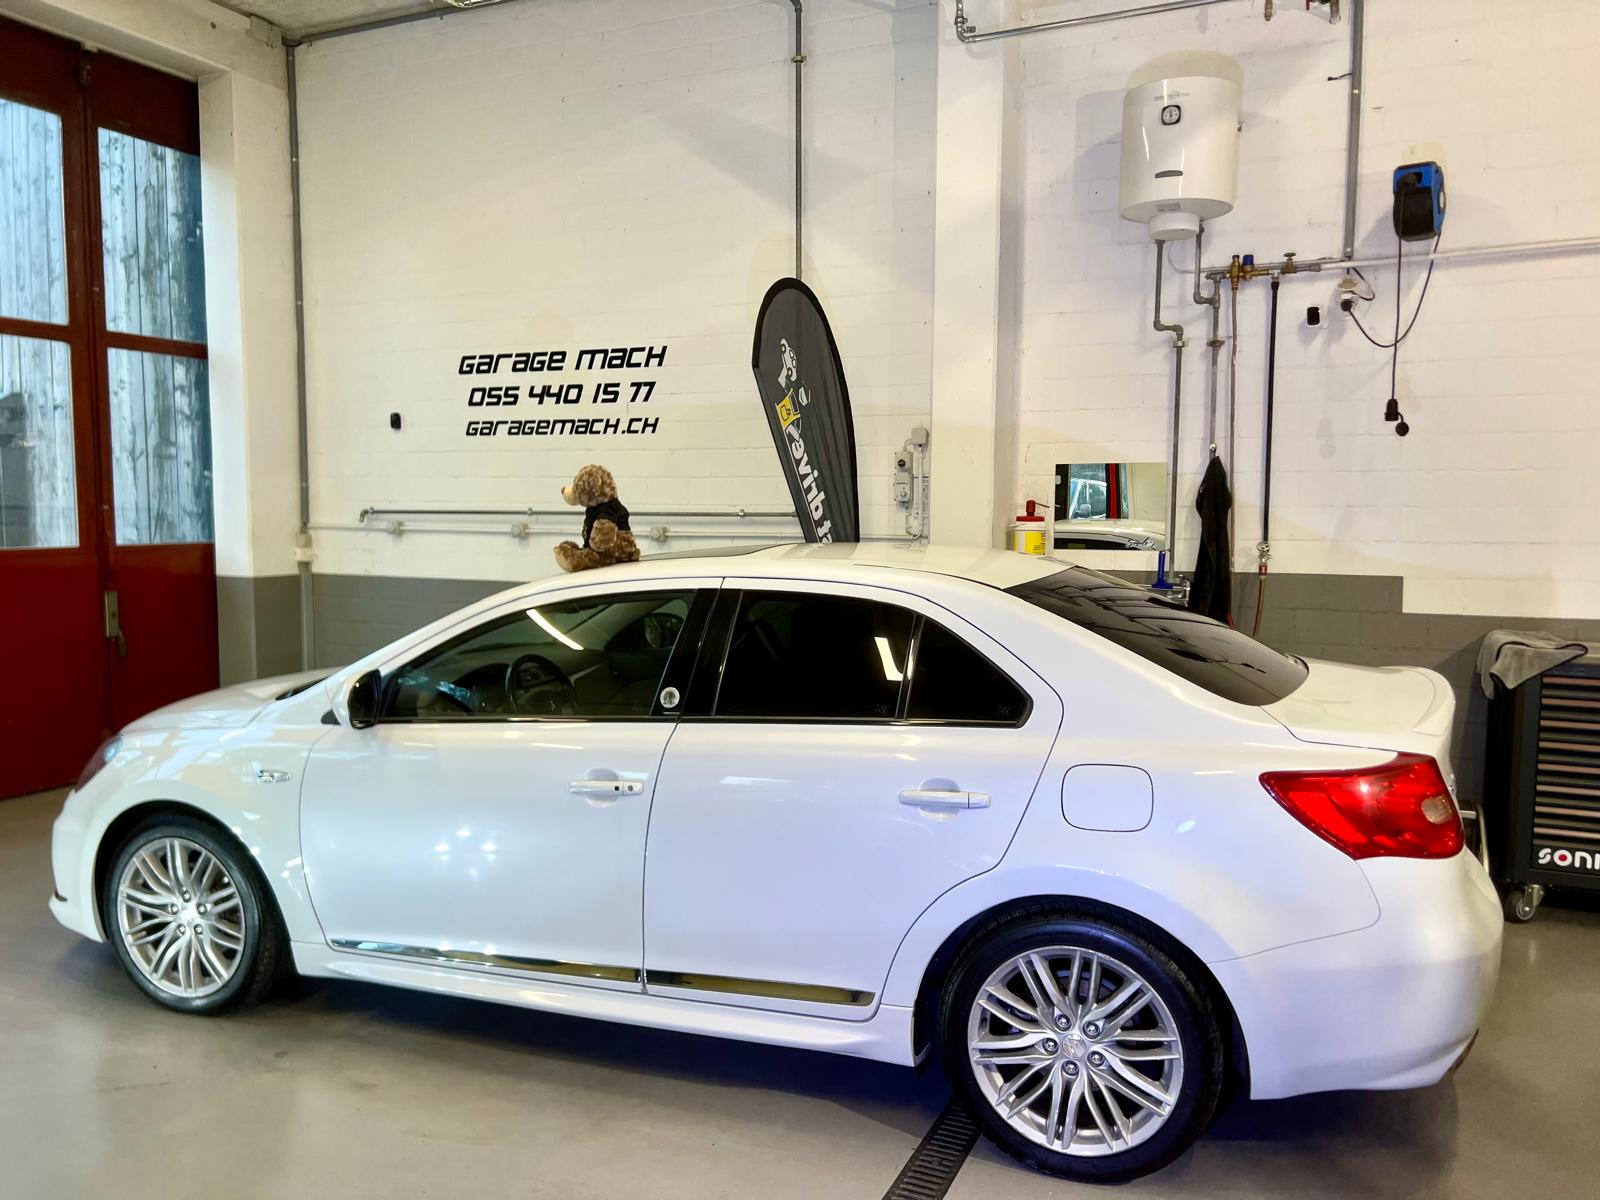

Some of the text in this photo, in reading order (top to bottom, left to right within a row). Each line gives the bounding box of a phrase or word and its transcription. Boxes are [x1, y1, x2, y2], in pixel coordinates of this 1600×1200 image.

[468, 381, 656, 406] 055 440 15 77
